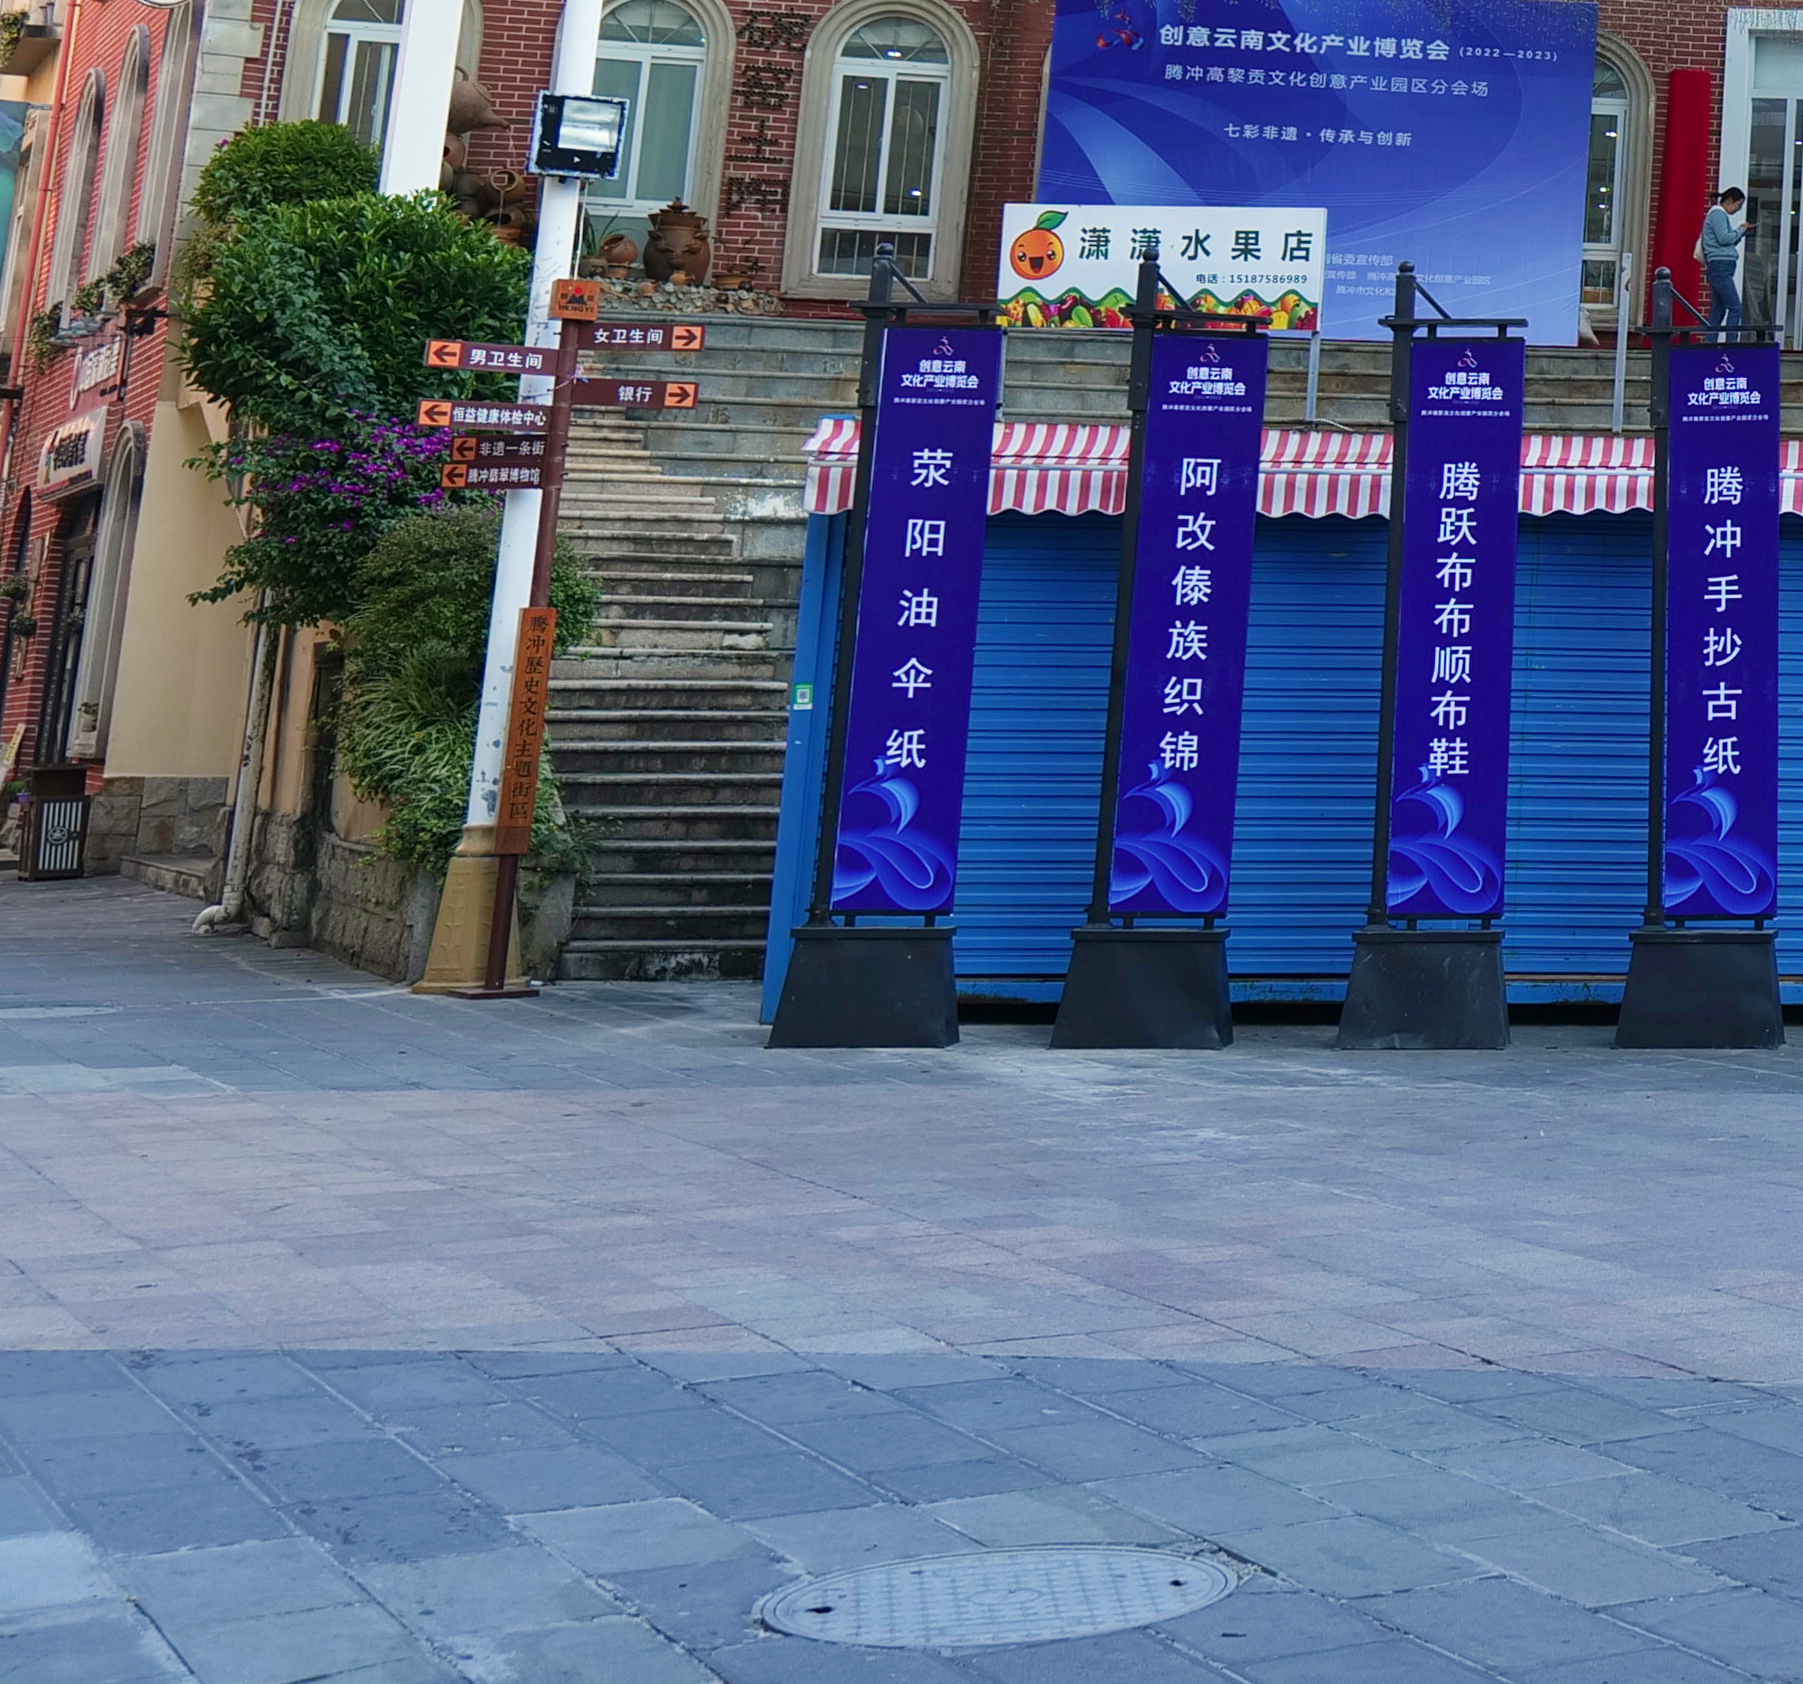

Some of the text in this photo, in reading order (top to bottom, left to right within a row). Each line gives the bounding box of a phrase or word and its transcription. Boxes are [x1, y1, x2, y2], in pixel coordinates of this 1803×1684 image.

[1157, 22, 1451, 62] 创意云南文化产业博览会
[1164, 62, 1490, 98] 腾冲高黎贡文化创意产业园区分会场
[1222, 122, 1414, 148] 七彩非遗·传承与创新
[1078, 227, 1313, 262] 潇潇水果店
[1366, 271, 1492, 285] 腾冲高文化创意产业园区
[1336, 284, 1396, 296] 腾冲市文化和
[593, 327, 664, 345] 女卫生间
[468, 349, 543, 371] 男卫生间
[919, 360, 966, 373] 创意云南
[900, 374, 979, 389] 文化产业博览会
[1186, 367, 1233, 381] 创意云南
[1445, 372, 1490, 385] 创意云南
[1168, 381, 1246, 395] 文化产业博览会
[1427, 387, 1503, 400] 文化产业博览会
[1703, 378, 1748, 391] 创意云南
[617, 385, 653, 403] 银行
[1687, 391, 1761, 406] 文化产业博览会
[452, 407, 547, 427] 恒益健康体检中心
[478, 441, 545, 458] 非遗一条街
[467, 466, 541, 485] 腾冲翡翠博物馆
[886, 449, 953, 769] 荥阳油伞纸
[1160, 458, 1222, 771] 阿改傣族织锦
[1429, 462, 1481, 777] 腾跃布布顺布鞋
[1702, 467, 1744, 776] 腾冲手抄古纸
